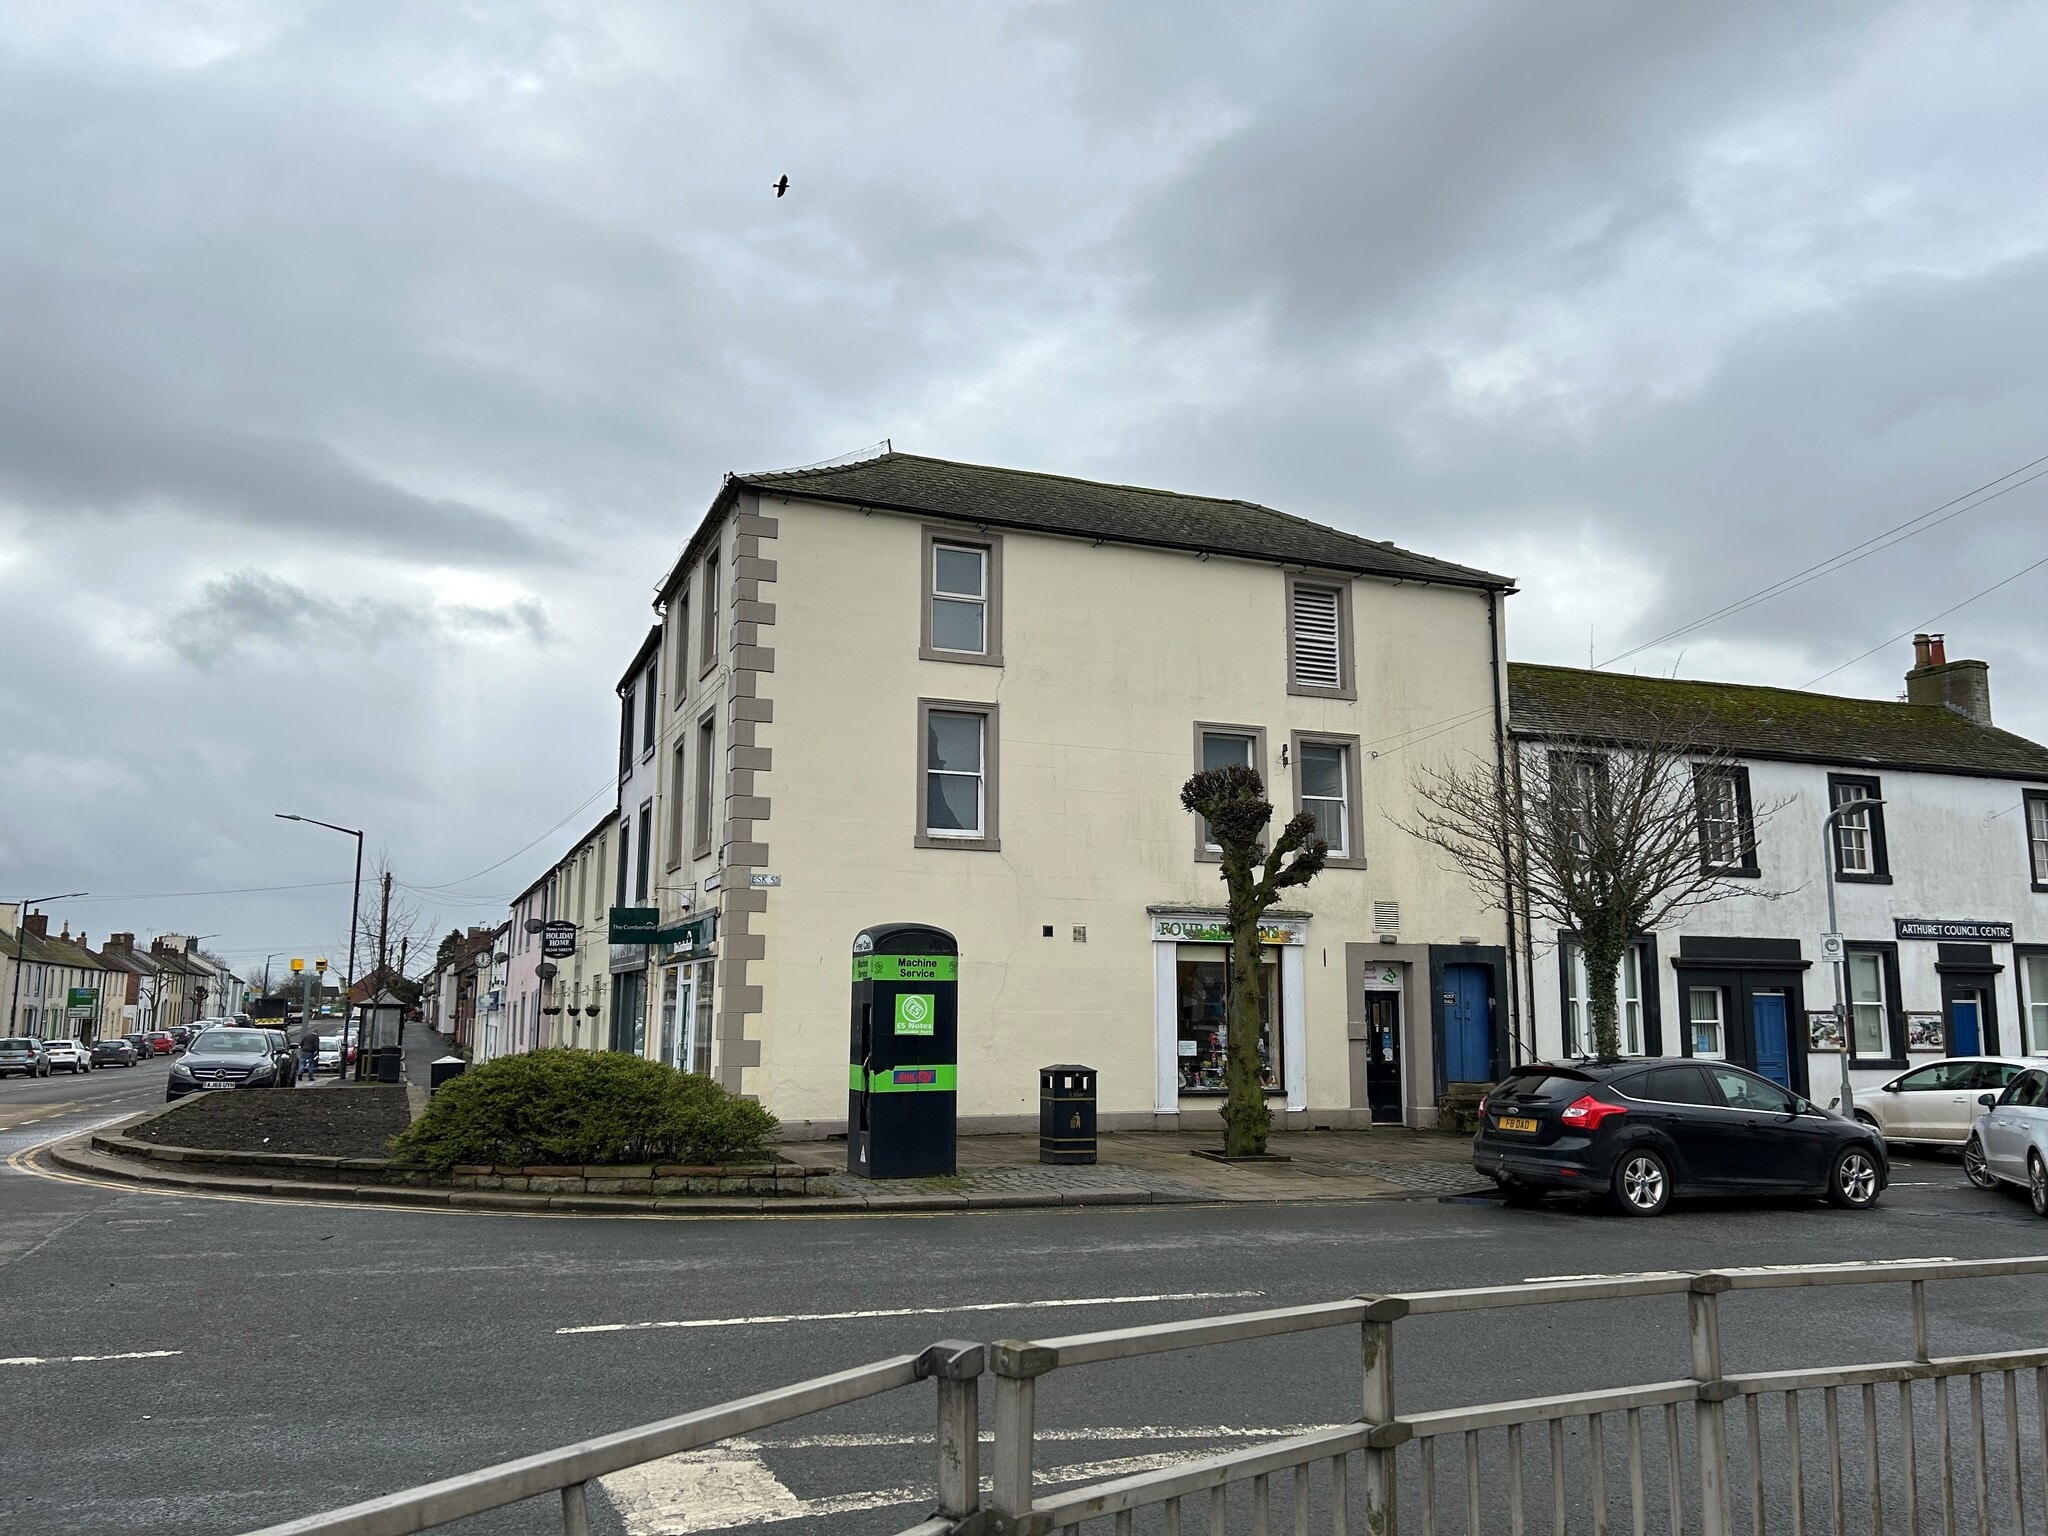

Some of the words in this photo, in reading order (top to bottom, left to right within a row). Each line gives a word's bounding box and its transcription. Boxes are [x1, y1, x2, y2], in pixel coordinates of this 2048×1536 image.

[751, 875, 767, 884] ESK
[1158, 922, 1204, 936] FOUR
[1209, 923, 1279, 938] SENS
[1901, 924, 1943, 935] ARTHURET
[1943, 925, 1980, 936] COUNCIL
[1980, 926, 2011, 937] CENTRE
[898, 958, 937, 967] Machine
[899, 969, 935, 978] Service
[1506, 1119, 1515, 1128] F8
[1516, 1120, 1530, 1130] DAD
